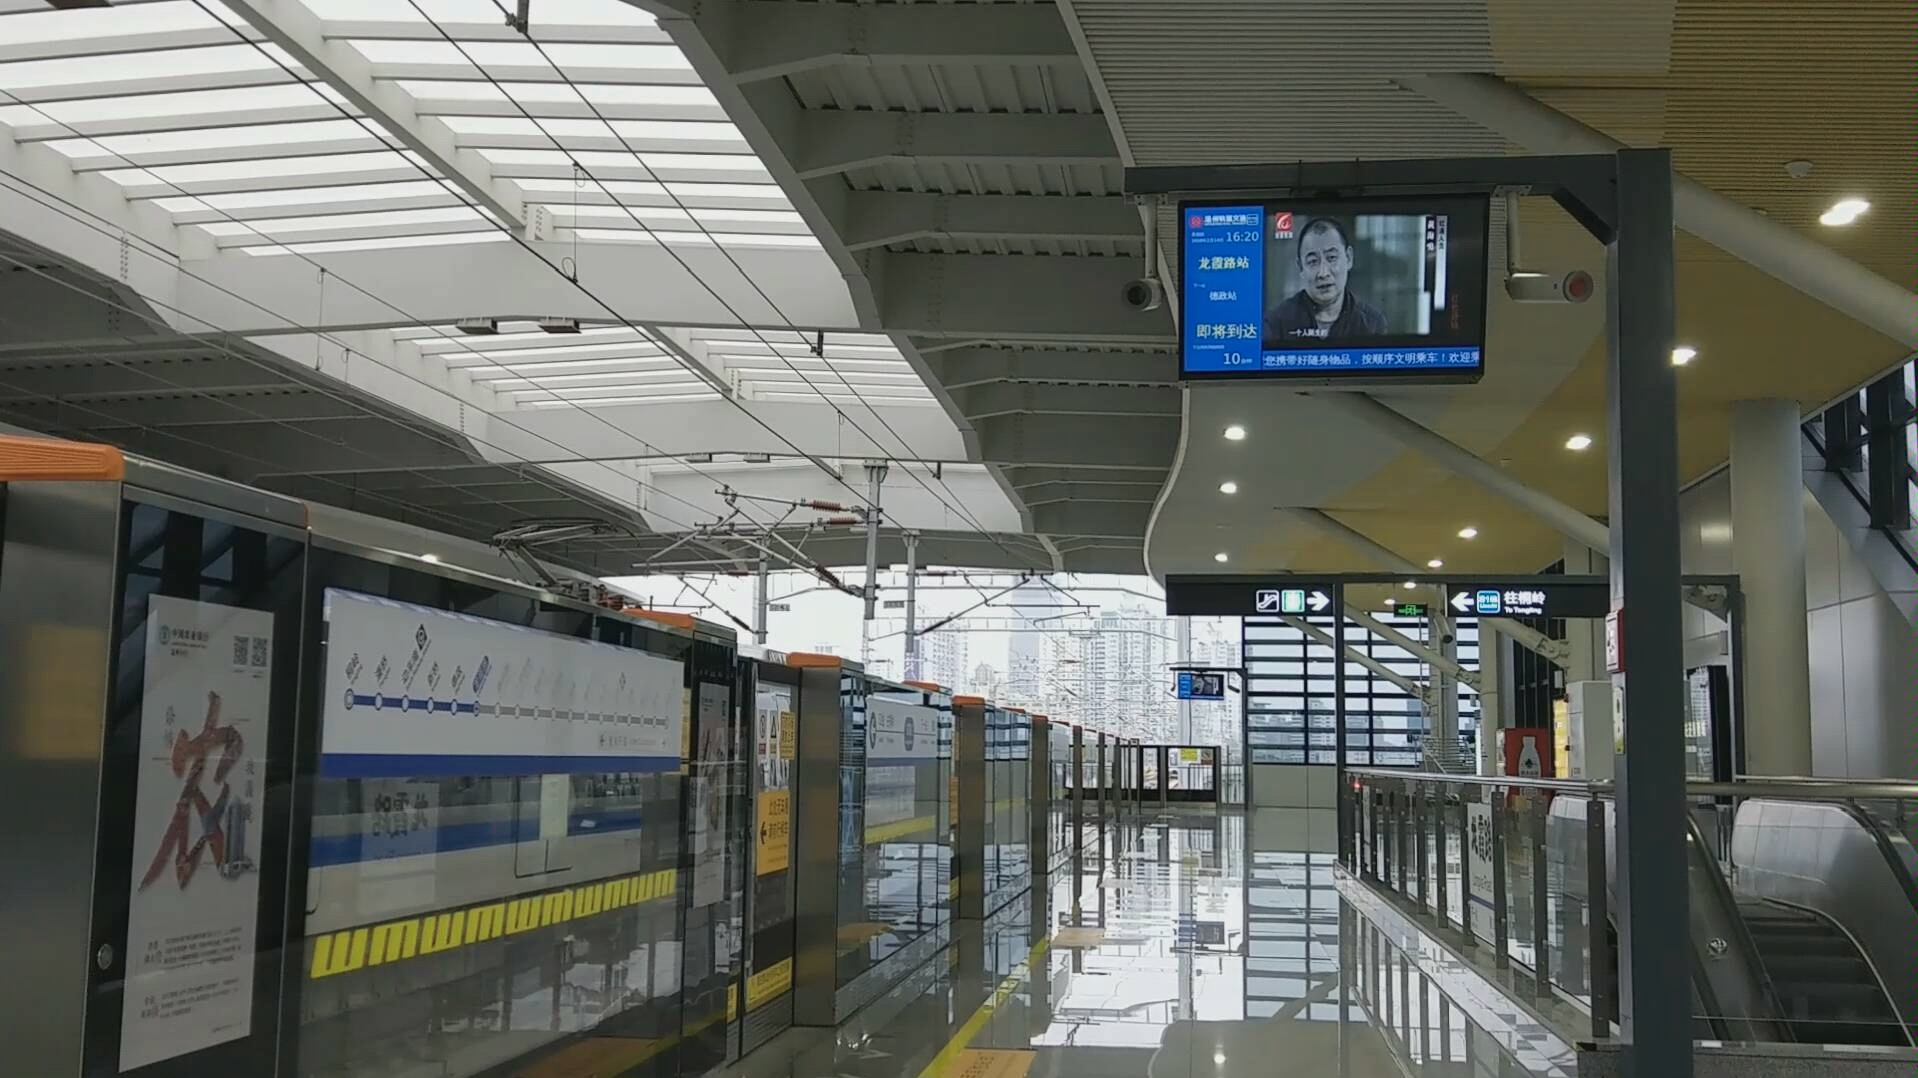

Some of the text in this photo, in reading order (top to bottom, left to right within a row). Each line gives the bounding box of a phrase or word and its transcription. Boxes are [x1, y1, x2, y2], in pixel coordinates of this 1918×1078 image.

[1226, 231, 1259, 242] 16:20
[1198, 256, 1250, 270] 龙霞路站
[1209, 290, 1237, 301] 德政站
[1196, 324, 1257, 339] 即将到达
[1223, 353, 1241, 365] 10
[1503, 591, 1546, 605] 往桐岭
